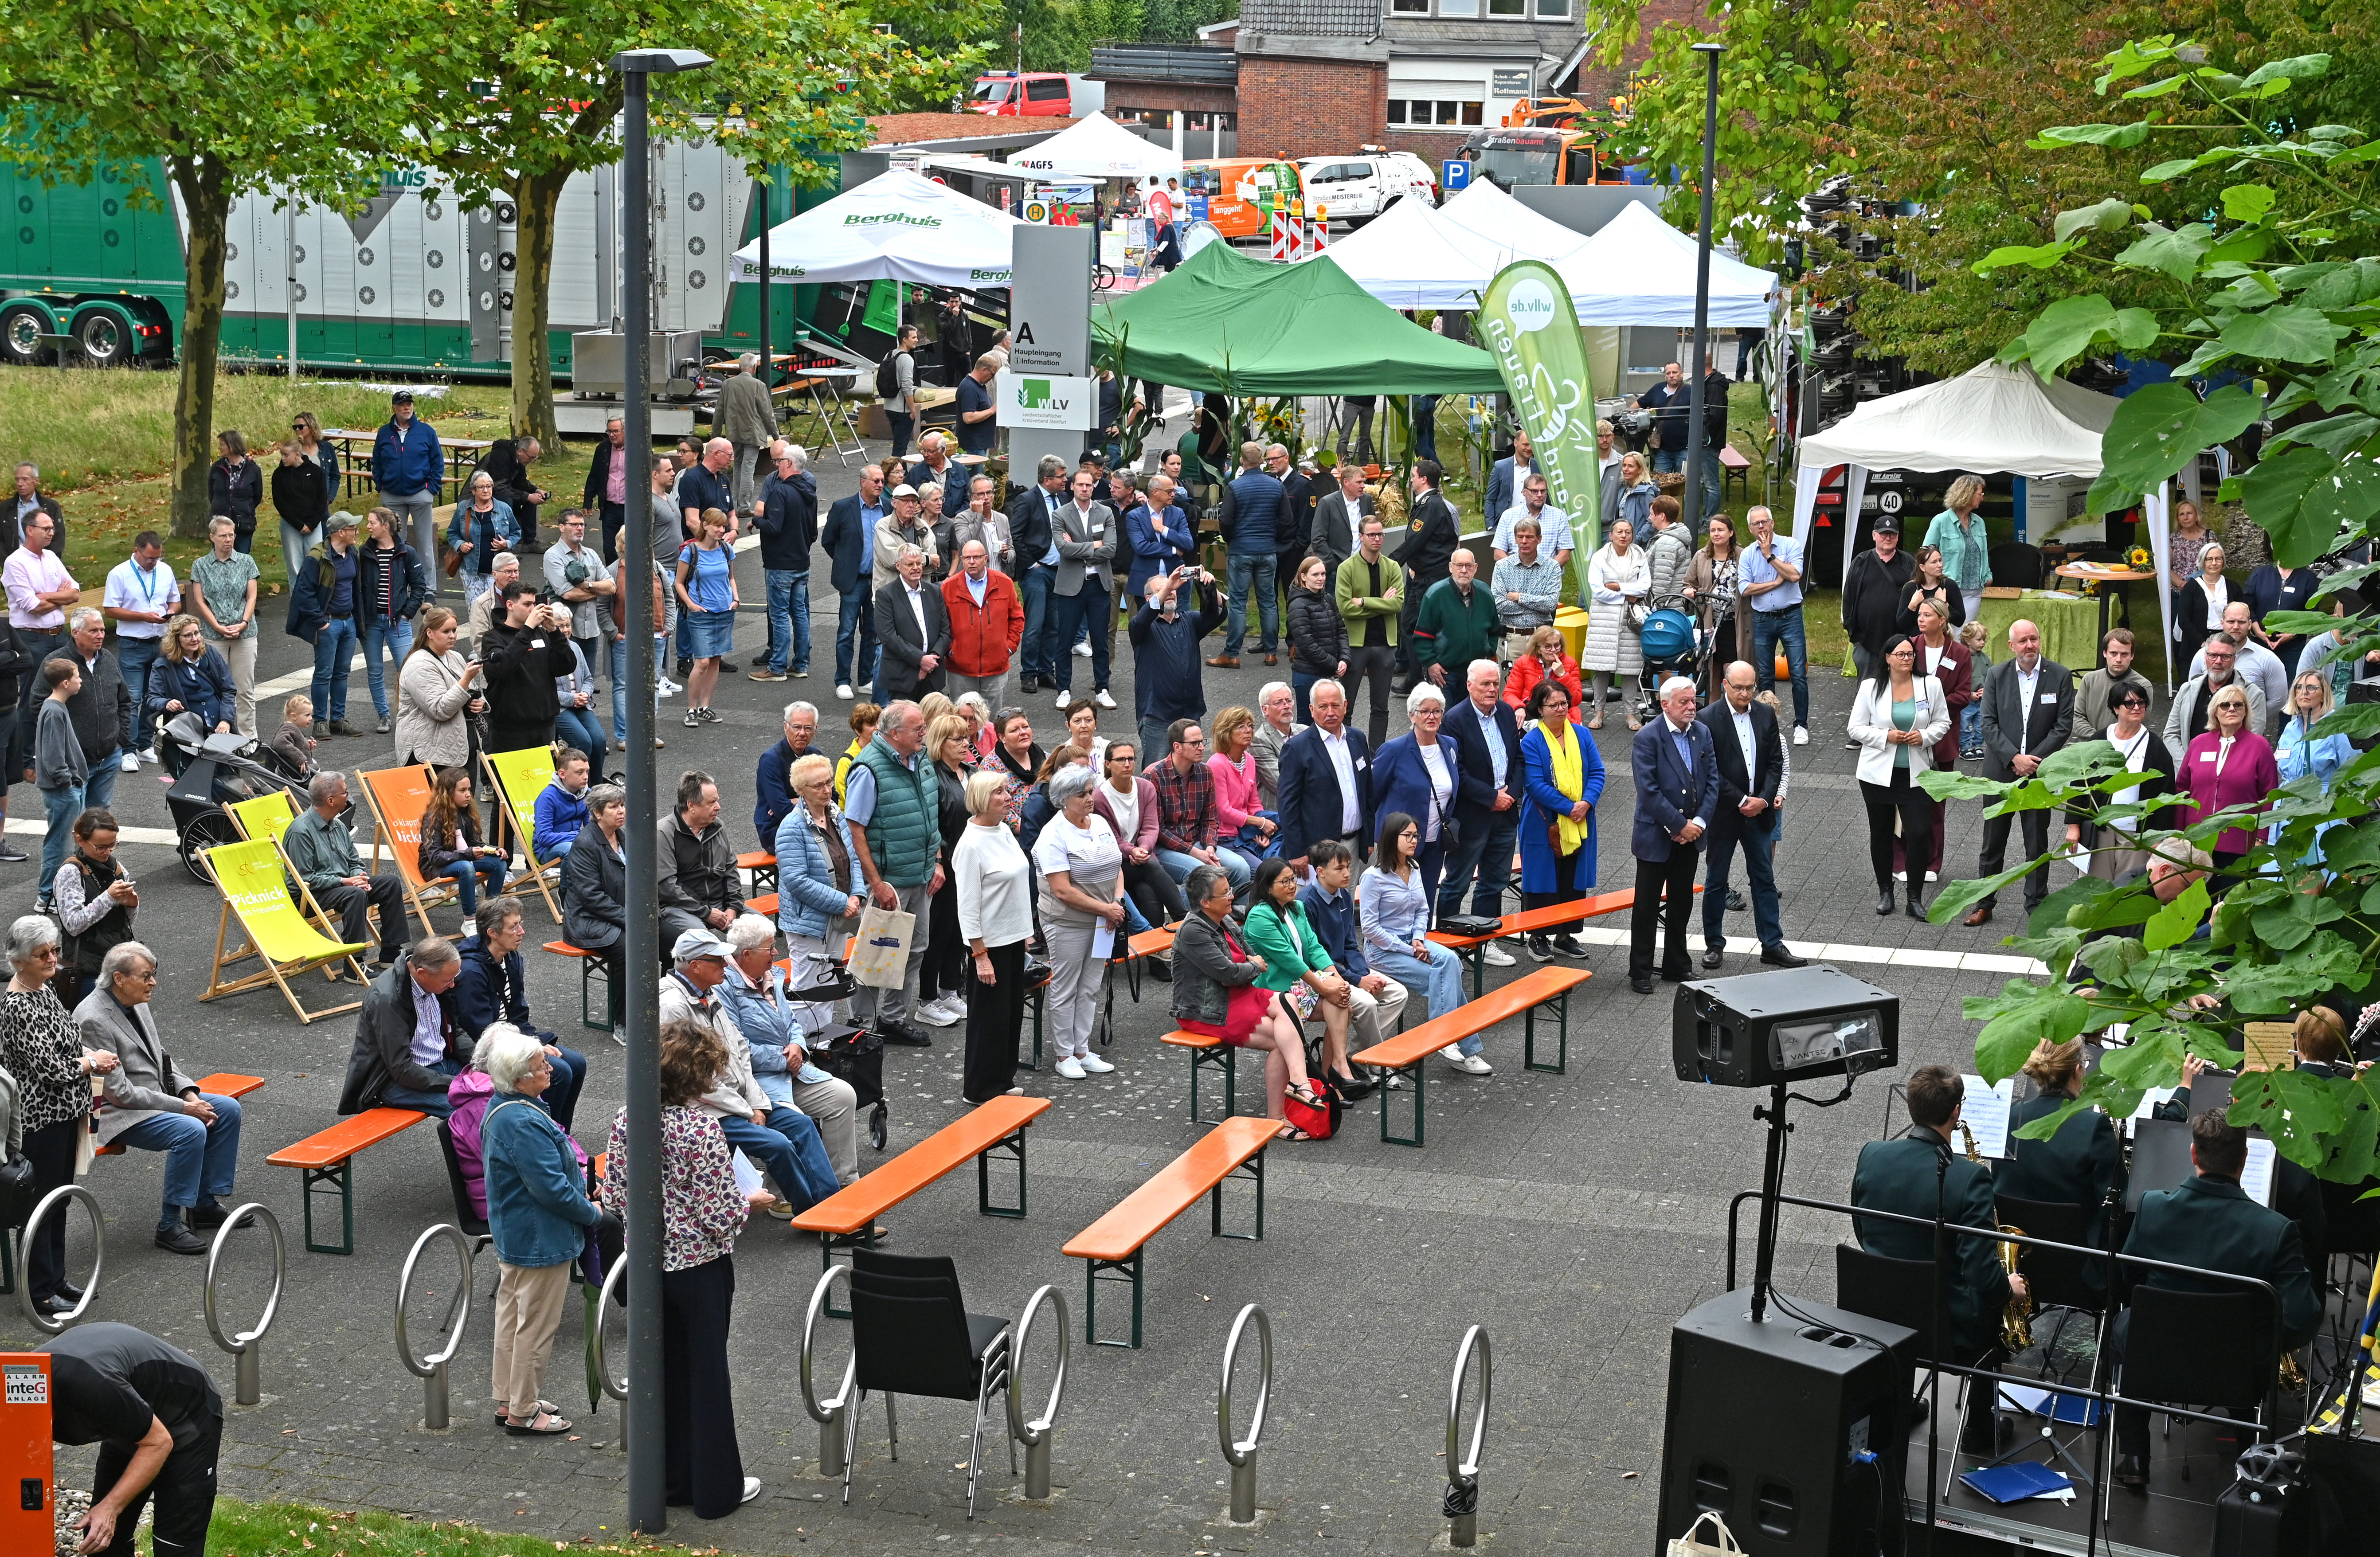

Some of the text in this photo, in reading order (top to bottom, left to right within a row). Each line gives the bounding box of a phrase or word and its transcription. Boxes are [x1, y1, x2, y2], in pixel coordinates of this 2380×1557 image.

[1481, 134, 1544, 148] Straßenbauamt
[1030, 160, 1053, 169] AGFS
[1448, 164, 1464, 186] P
[1032, 207, 1040, 218] H
[1213, 204, 1243, 215] langgeht!
[844, 212, 942, 227] Berghuis
[743, 263, 806, 277] Beghuis
[970, 269, 1013, 282] Bergh
[1015, 322, 1035, 344] A
[1014, 348, 1061, 358] Haupteingang
[1021, 358, 1060, 366] Information
[1037, 398, 1069, 410] WLV
[1884, 495, 1898, 509] 40
[91, 873, 102, 889] DIGITAL
[231, 885, 286, 907] Picknick
[251, 903, 286, 914] Freunden
[1790, 1049, 1826, 1060] VANTEC
[7, 1382, 46, 1393] inteG
